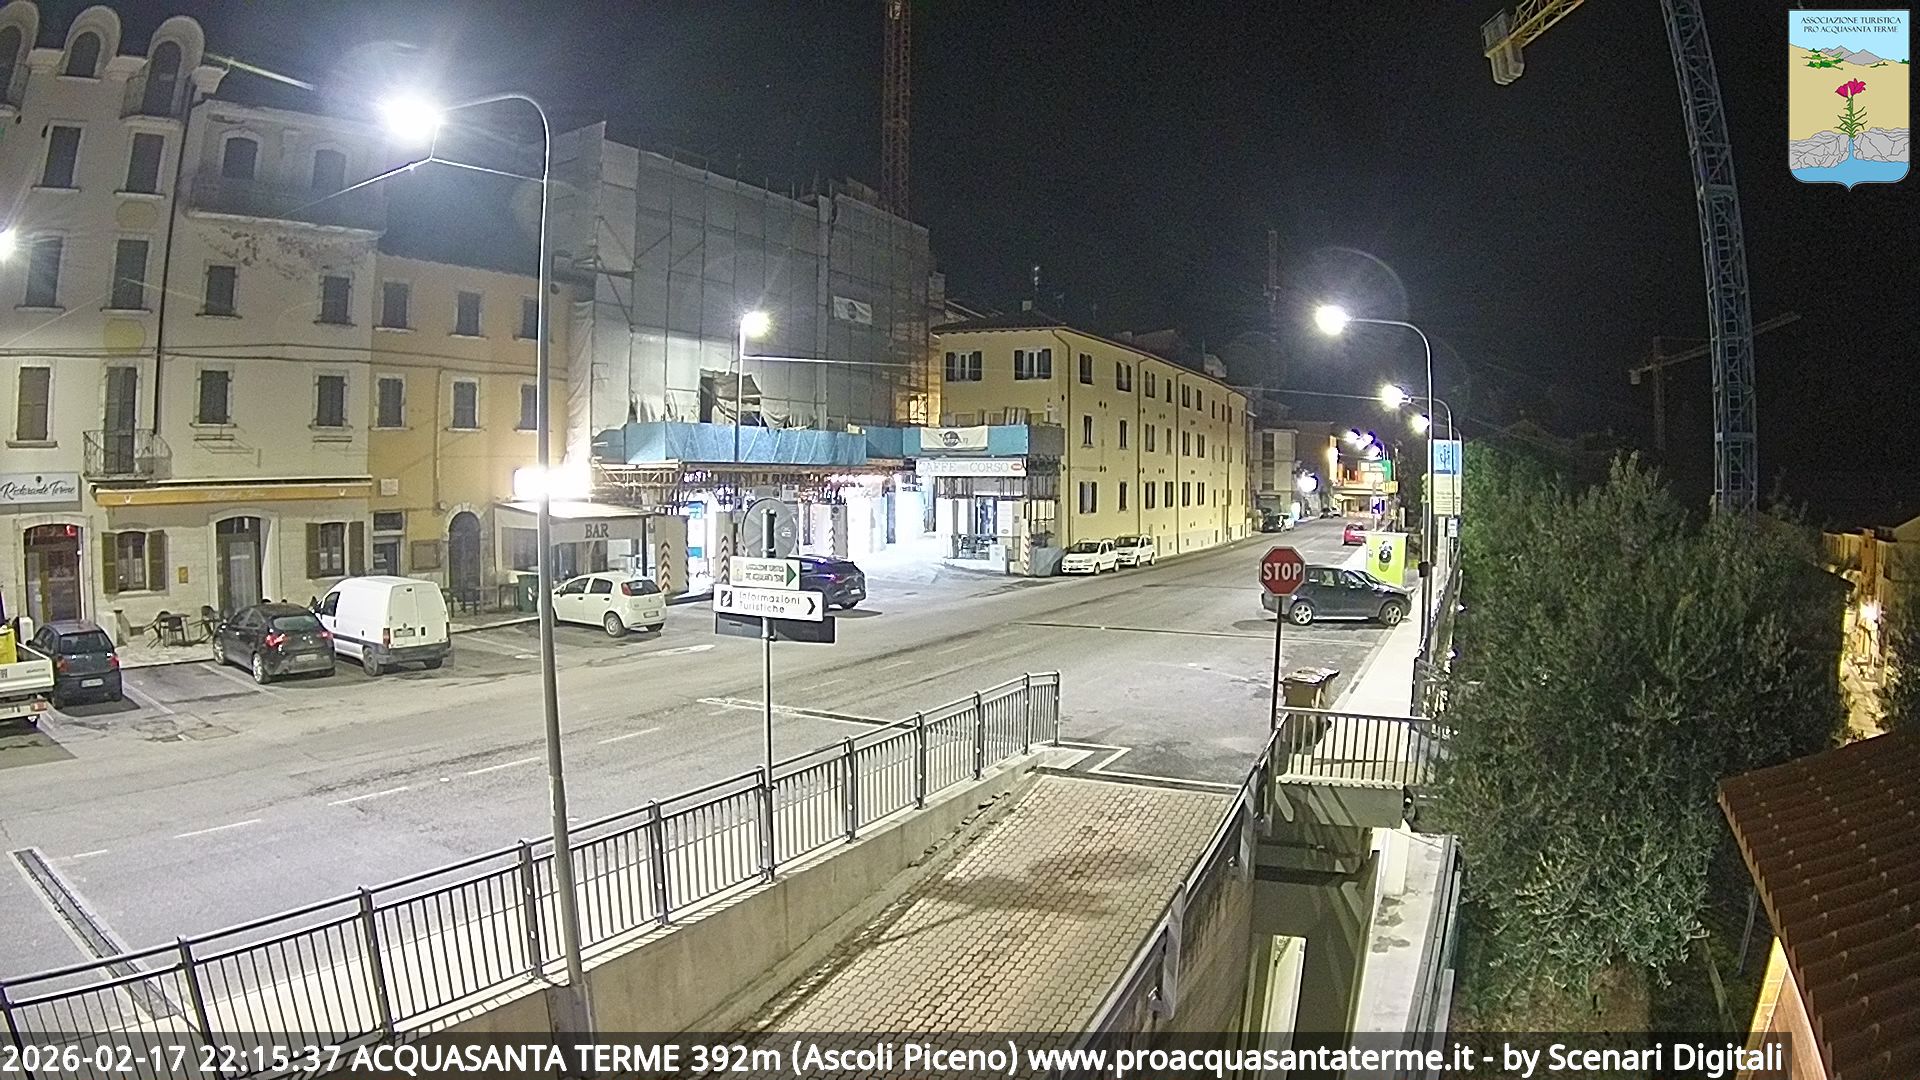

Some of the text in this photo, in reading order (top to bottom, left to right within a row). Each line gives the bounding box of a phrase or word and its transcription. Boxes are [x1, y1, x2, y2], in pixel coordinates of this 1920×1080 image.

[969, 462, 1010, 473] CORSO
[584, 523, 609, 539] BAR
[1263, 562, 1302, 581] STOP
[739, 591, 800, 605] Informazioni
[739, 600, 785, 614] Turistiche
